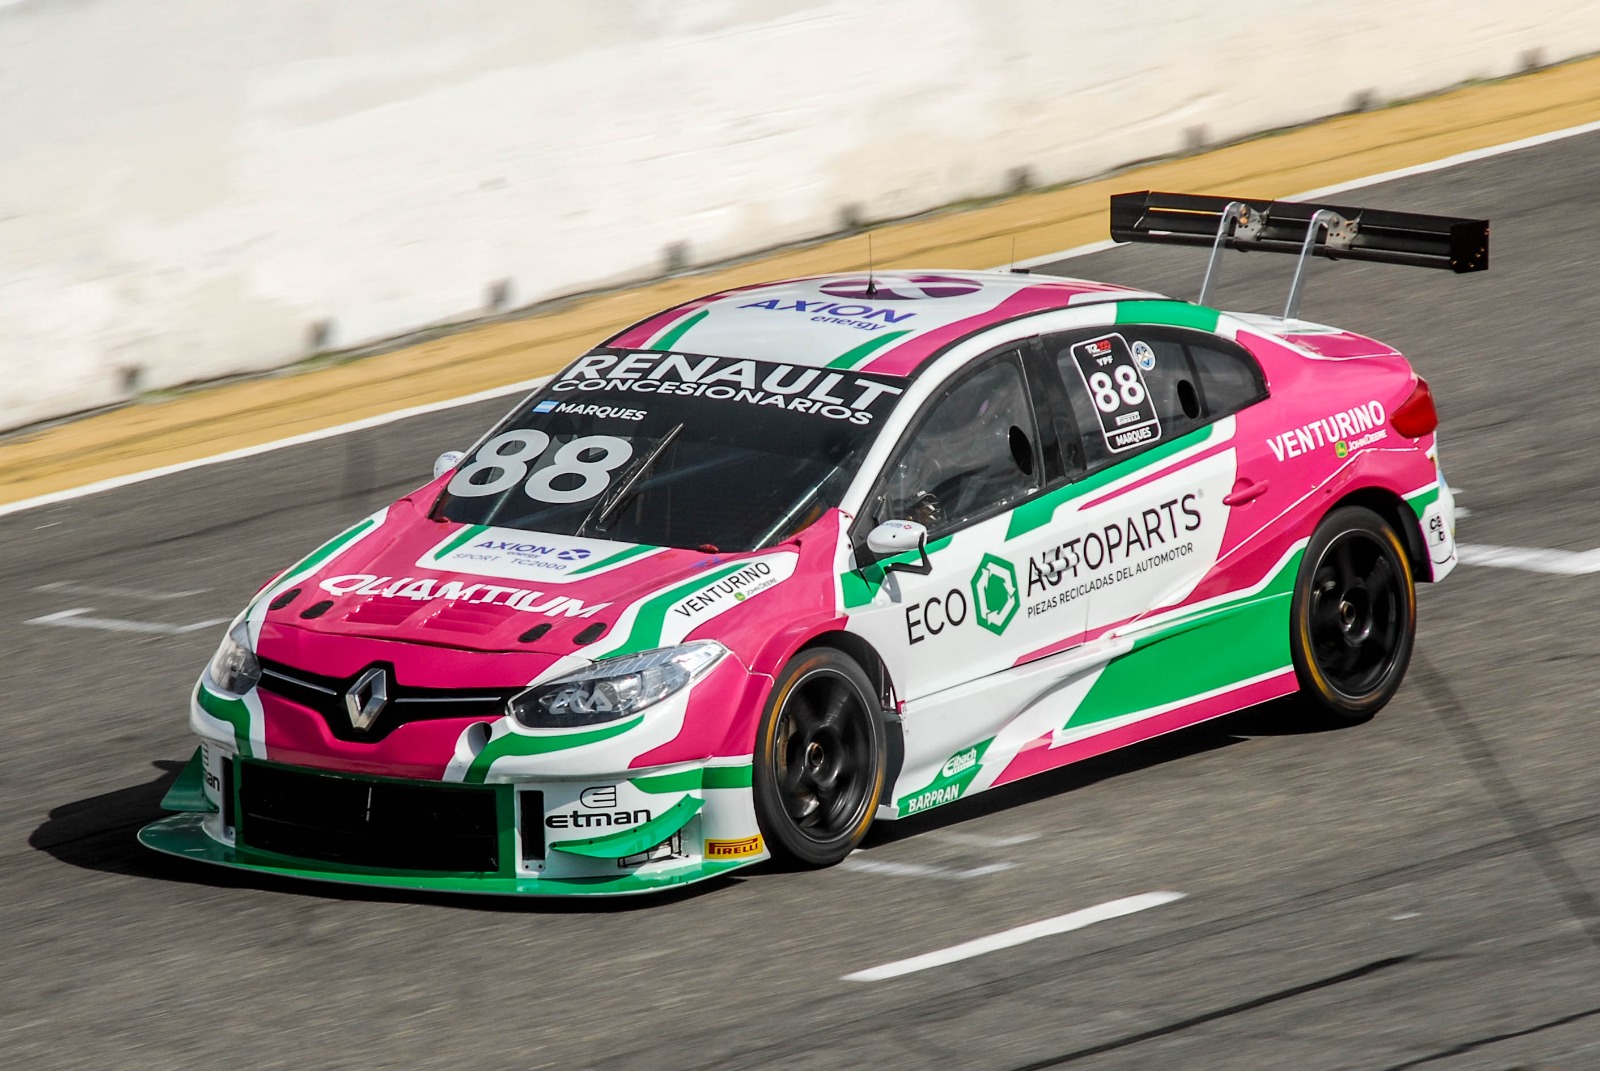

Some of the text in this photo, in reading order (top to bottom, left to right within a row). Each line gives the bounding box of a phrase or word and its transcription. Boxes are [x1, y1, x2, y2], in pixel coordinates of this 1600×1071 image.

[736, 299, 917, 324] AXION
[811, 315, 887, 331] energy
[561, 353, 904, 411] RENAULT
[1089, 364, 1145, 413] 88
[552, 379, 873, 425] CONCESIONARIOS
[555, 403, 647, 421] MARQUES
[1115, 426, 1152, 446] MARQUES
[1266, 400, 1386, 462] VENTURINO
[447, 428, 634, 504] 88
[474, 540, 556, 555] AXION
[507, 551, 541, 559] energy
[453, 553, 567, 571] SPORT TC2000
[906, 493, 1202, 646] ECO AUTOPARTS
[674, 562, 771, 618] VENTURINO
[1027, 542, 1194, 618] PIEZAS RECICLADAS DEL AUTOMOTOR
[908, 783, 960, 813] BARPRAN
[545, 809, 651, 829] etman
[709, 838, 758, 855] PIRELLI
